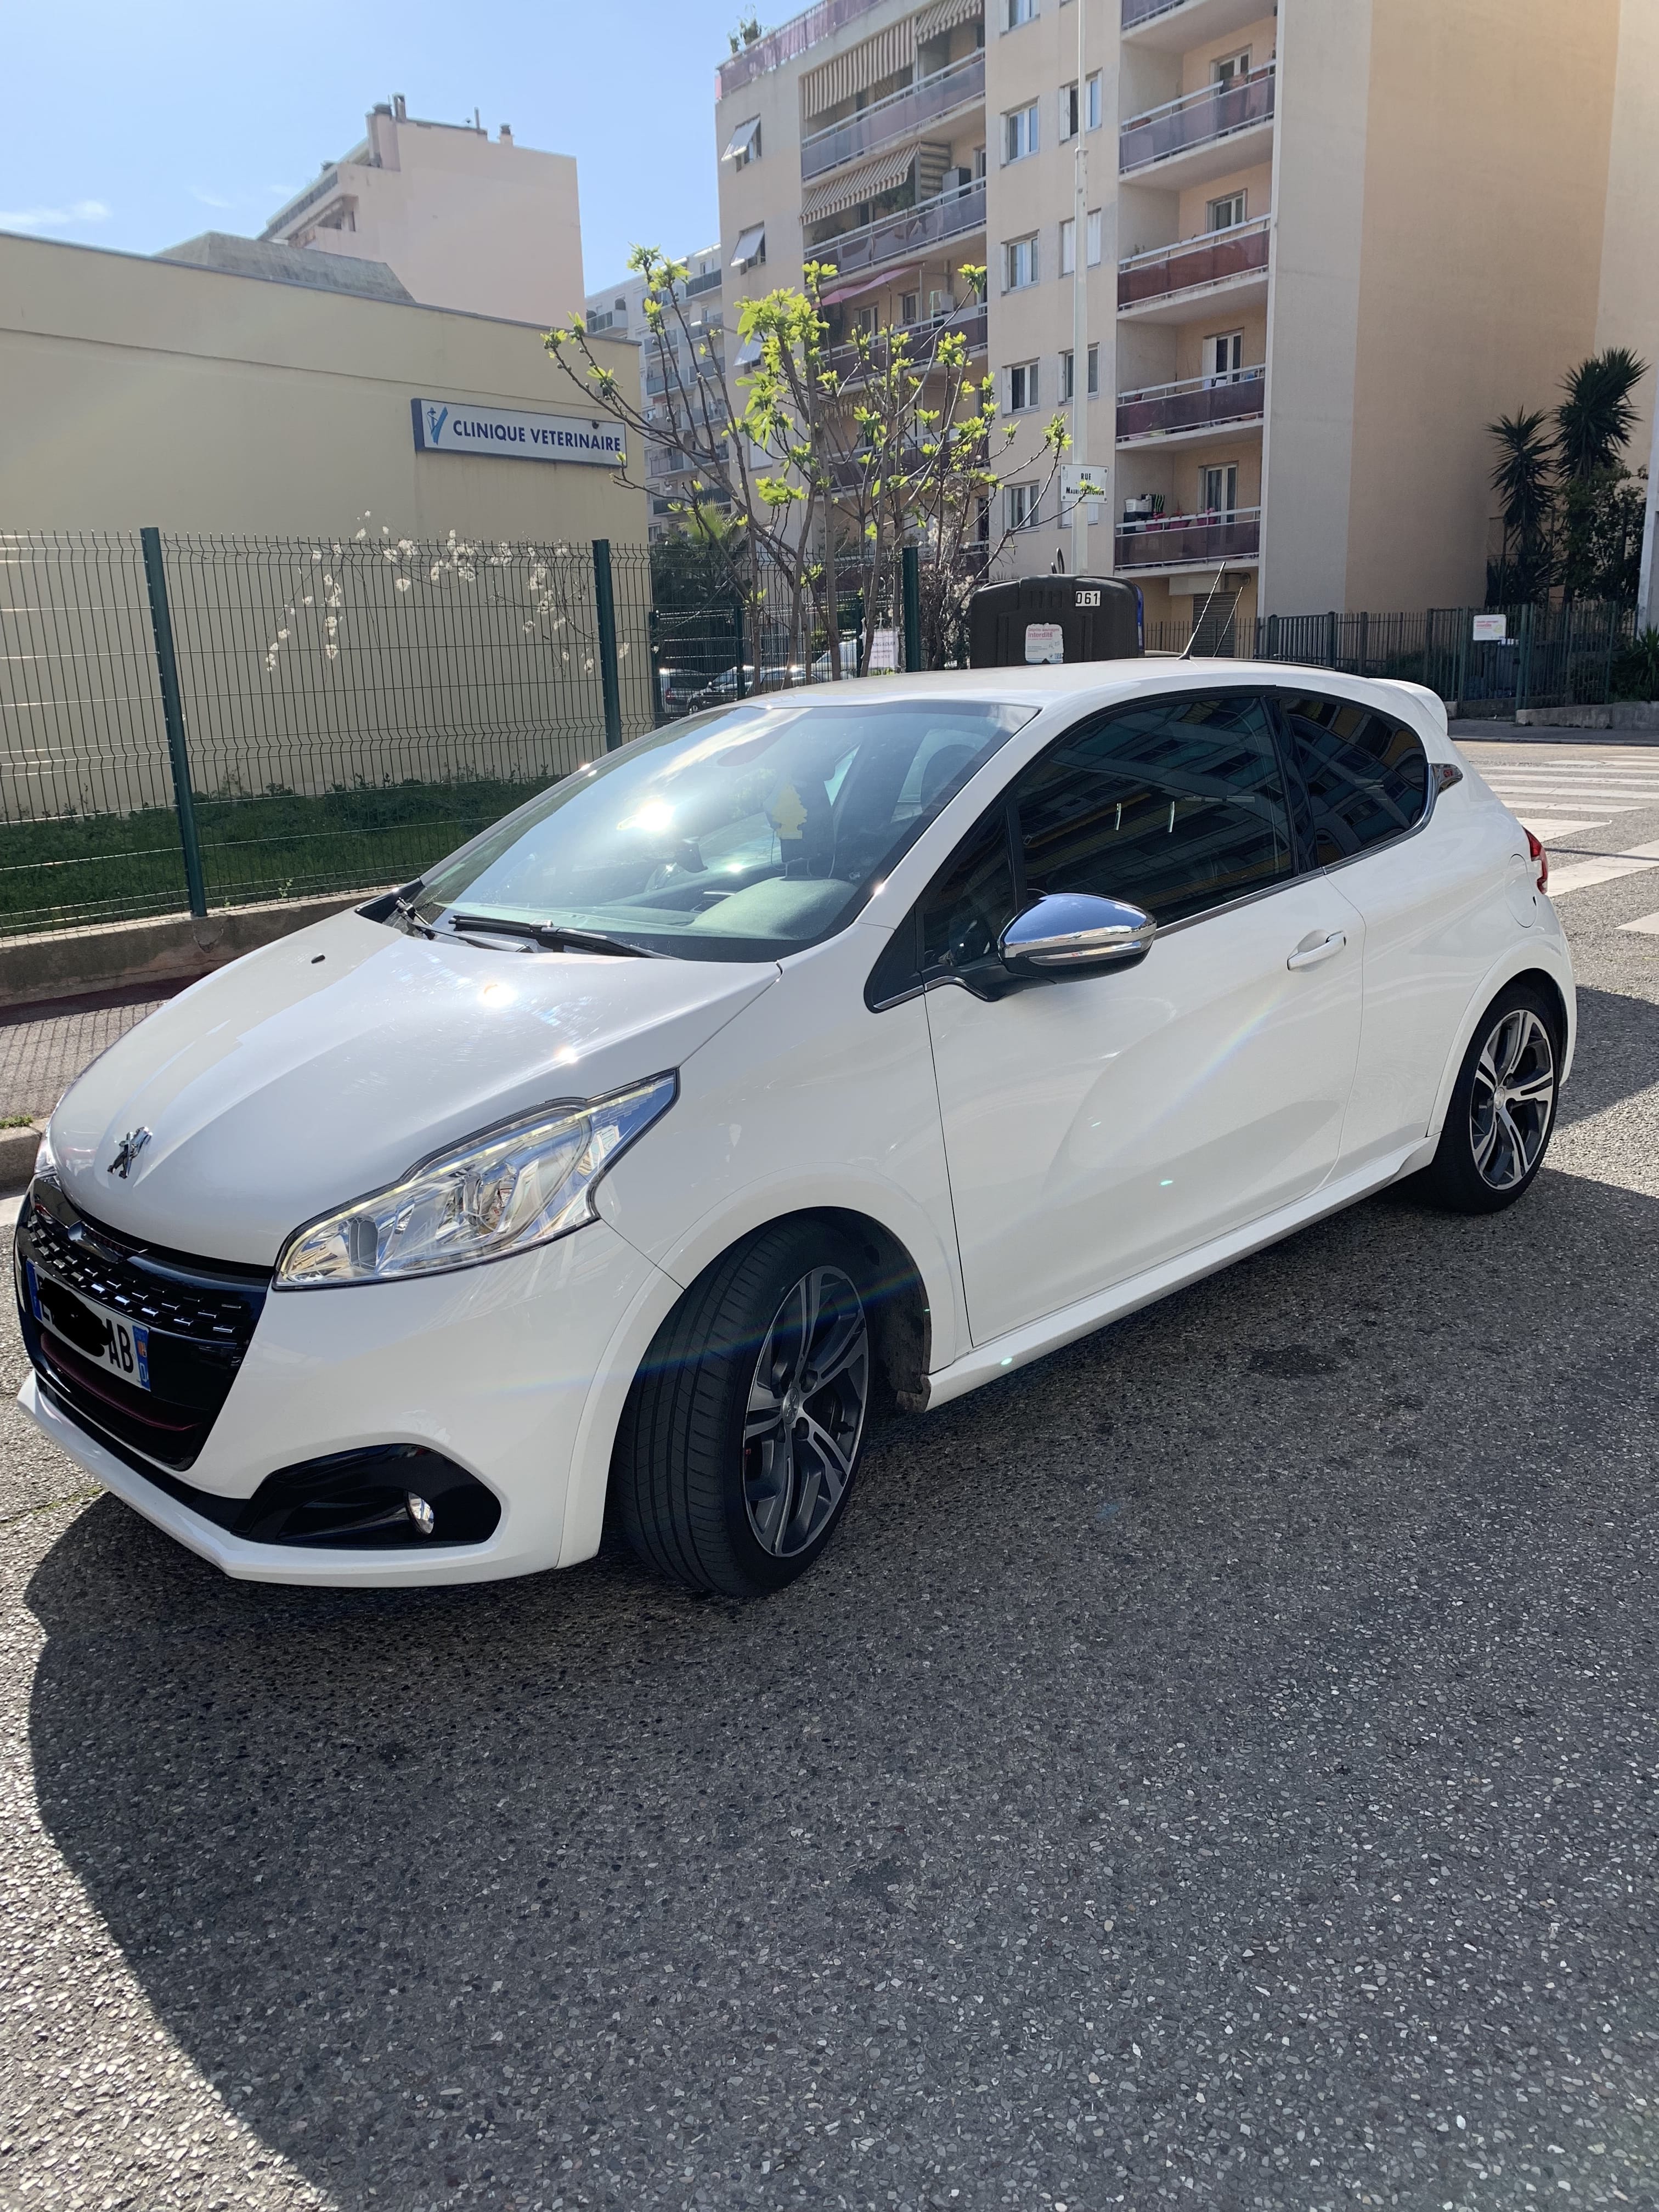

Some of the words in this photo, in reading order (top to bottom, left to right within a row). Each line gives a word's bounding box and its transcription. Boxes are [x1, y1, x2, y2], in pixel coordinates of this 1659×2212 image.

[453, 420, 526, 442] CLINIQUE
[530, 428, 620, 452] VETERINAIRE
[1076, 592, 1098, 605] 061
